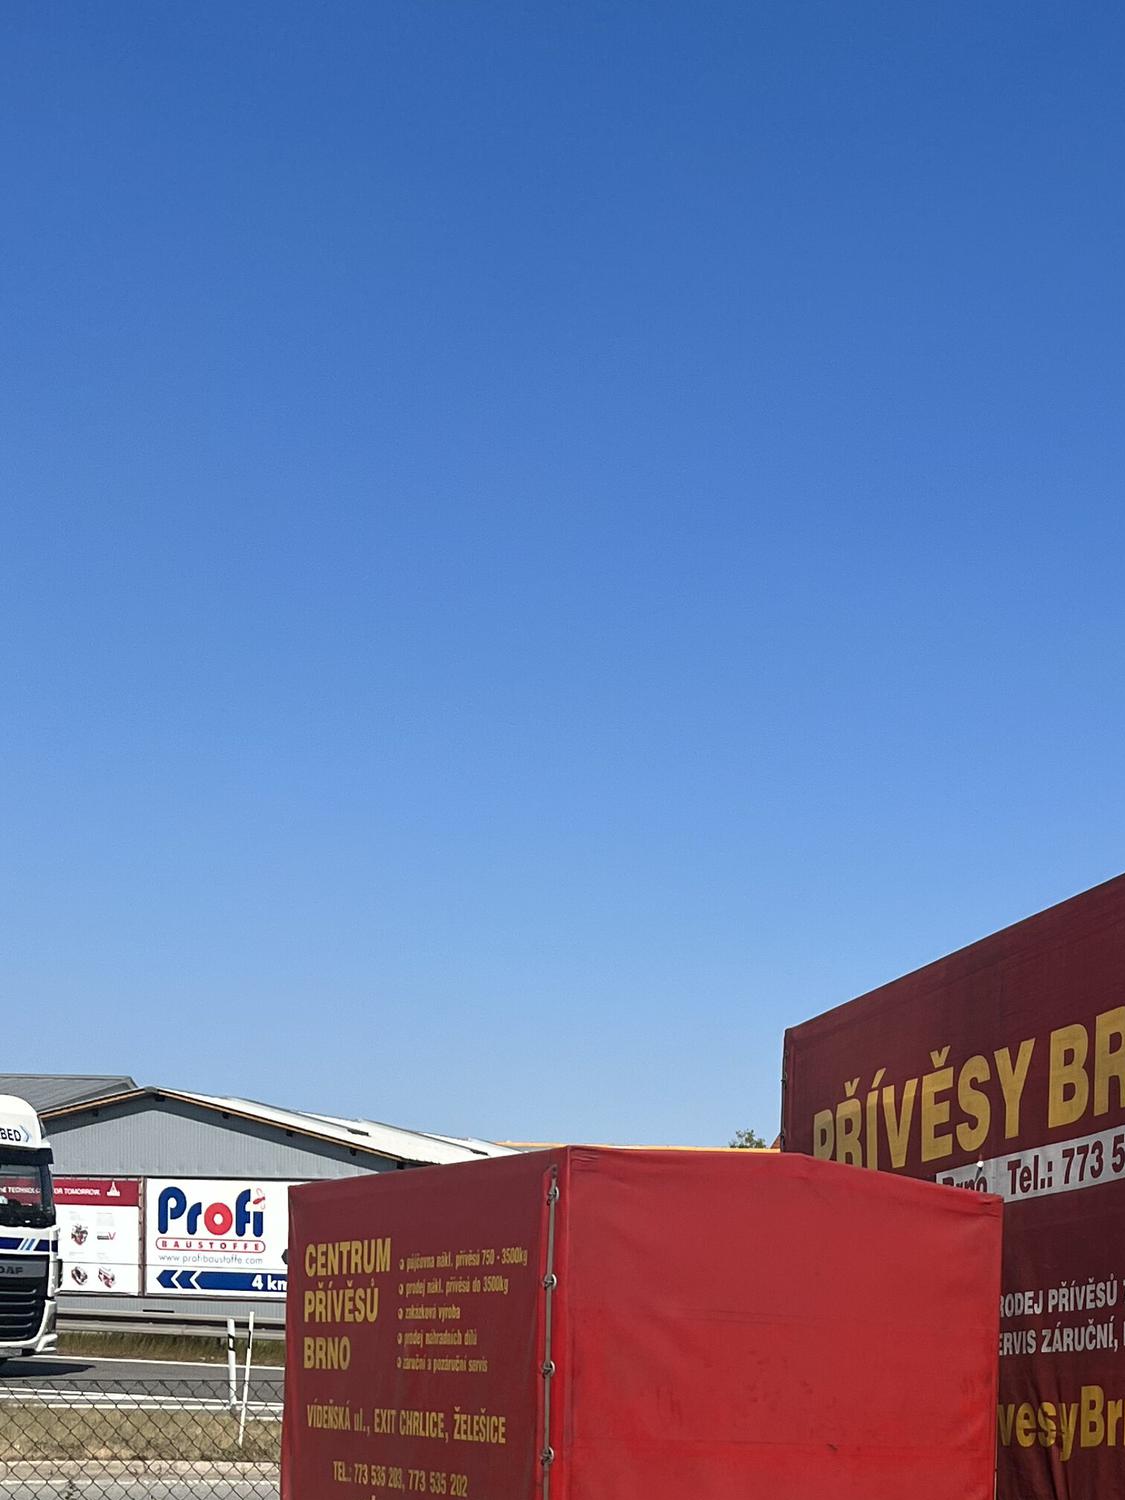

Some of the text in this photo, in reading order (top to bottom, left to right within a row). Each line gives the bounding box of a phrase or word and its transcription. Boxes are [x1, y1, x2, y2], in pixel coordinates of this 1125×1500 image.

[813, 1037, 1036, 1171] PŘÍVĚSY
[1007, 1155, 1053, 1195] Tel.:
[1062, 1143, 1104, 1185] 773
[158, 1187, 265, 1237] Profi
[161, 1240, 259, 1251] BAUSTOFFE
[305, 1238, 391, 1277] CENTRUM
[252, 1275, 263, 1289] 4
[304, 1278, 379, 1323] PŘÍVĚSŮ
[1048, 1273, 1117, 1313] PŘÍVĚSŮ
[1041, 1315, 1118, 1352] ZÁRUČNÍ,
[303, 1336, 350, 1370] BRNO
[374, 1408, 397, 1434] EXIT
[400, 1409, 449, 1443] CHRLICE,
[453, 1406, 506, 1444] ŽELEŠICE
[354, 1463, 369, 1485] 773
[408, 1469, 426, 1492] 773
[430, 1471, 447, 1495] 535
[450, 1473, 468, 1498] 202
